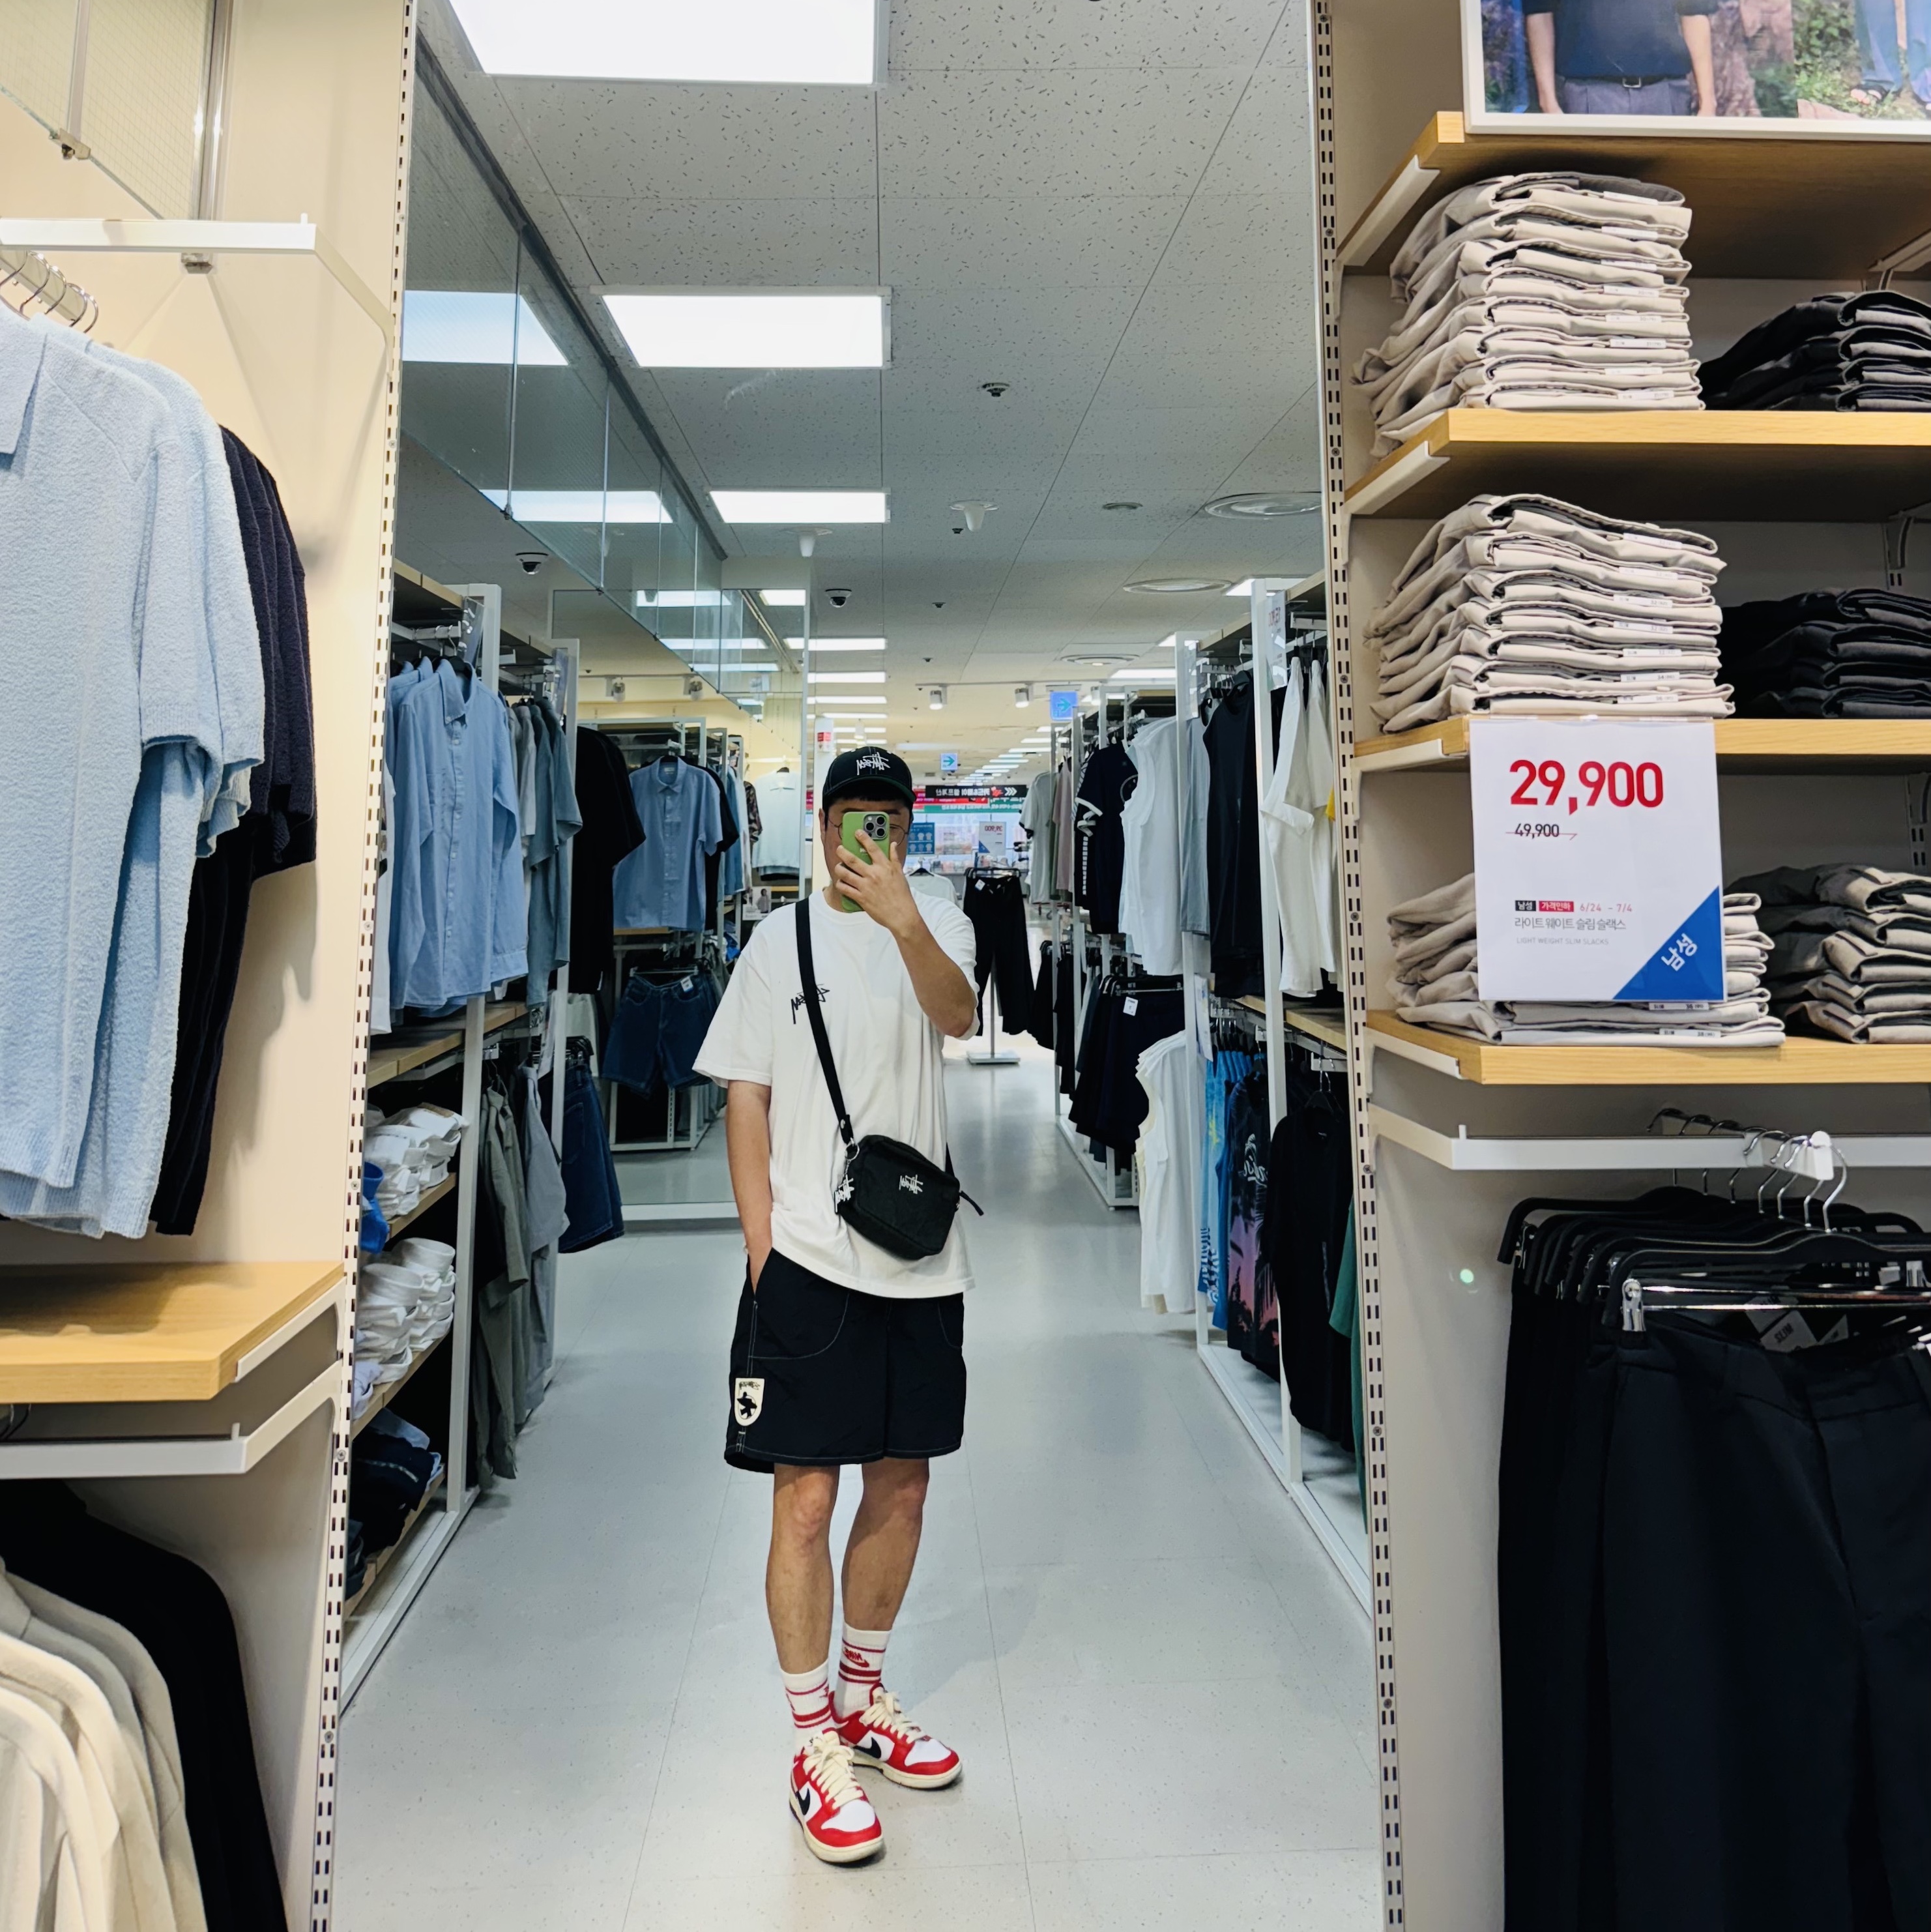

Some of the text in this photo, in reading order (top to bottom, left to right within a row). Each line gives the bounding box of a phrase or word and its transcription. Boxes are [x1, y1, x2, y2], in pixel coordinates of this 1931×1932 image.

[1509, 759, 1664, 815] 29,900
[1515, 823, 1560, 839] 49,900
[1518, 901, 1533, 911] 남성
[1541, 901, 1571, 911] 가격인하
[1580, 903, 1602, 913] 6/24
[1616, 903, 1633, 913] 7/4
[1515, 917, 1627, 931] 라이트 웨이트 슬림 슬랙스
[1661, 933, 1698, 972] 남성
[1774, 1323, 1793, 1343] SLIM
